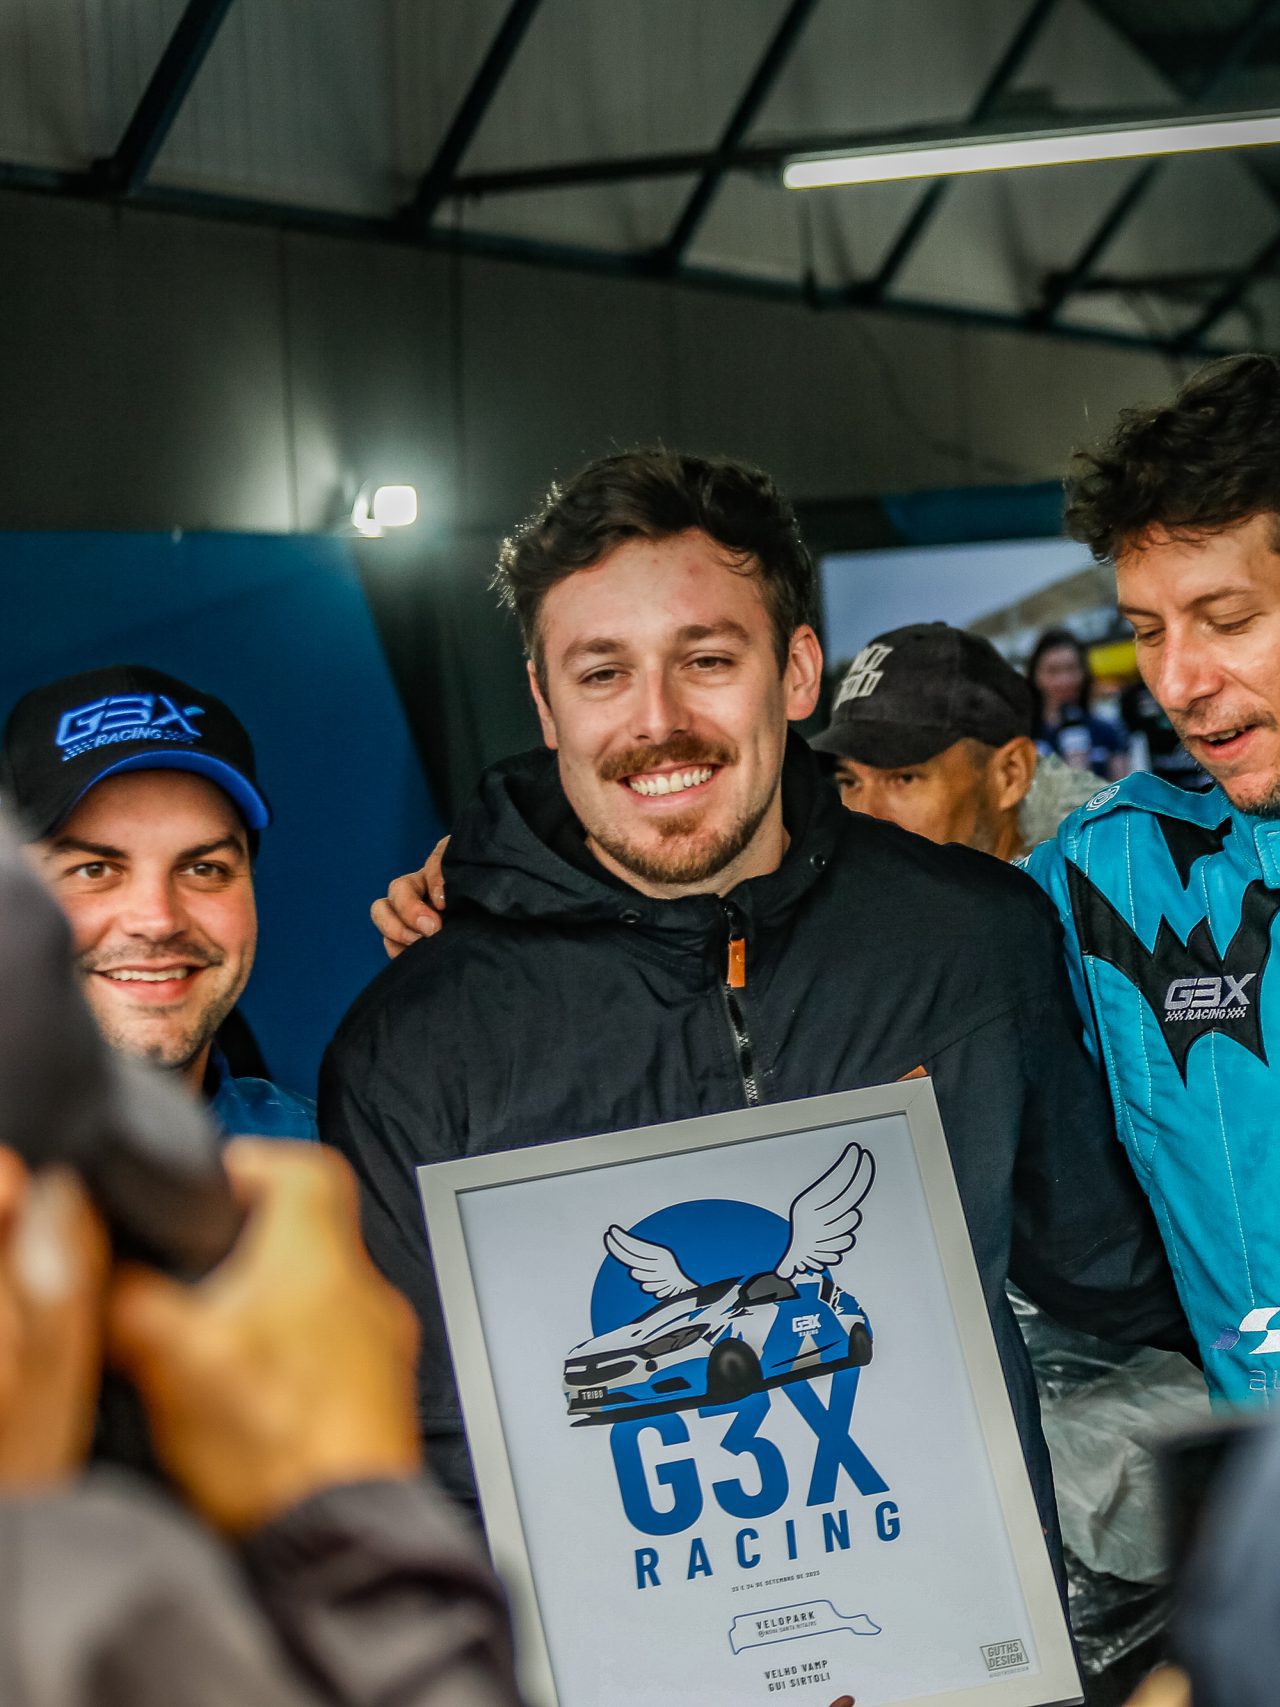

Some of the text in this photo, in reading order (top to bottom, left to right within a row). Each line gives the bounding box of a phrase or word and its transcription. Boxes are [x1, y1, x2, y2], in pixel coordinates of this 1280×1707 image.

[93, 727, 162, 747] RACING
[1164, 972, 1257, 1010] G3X
[1184, 1008, 1226, 1021] RACING
[792, 1313, 822, 1333] G3X
[609, 1366, 890, 1536] G3X
[634, 1501, 901, 1590] RACING
[756, 1611, 816, 1630] VELOPARK
[988, 1642, 1019, 1657] GUTHS
[764, 1659, 828, 1680] VELHO VAMP
[989, 1652, 1023, 1668] DESIGN
[768, 1672, 831, 1692] GUI SIRTOLI
